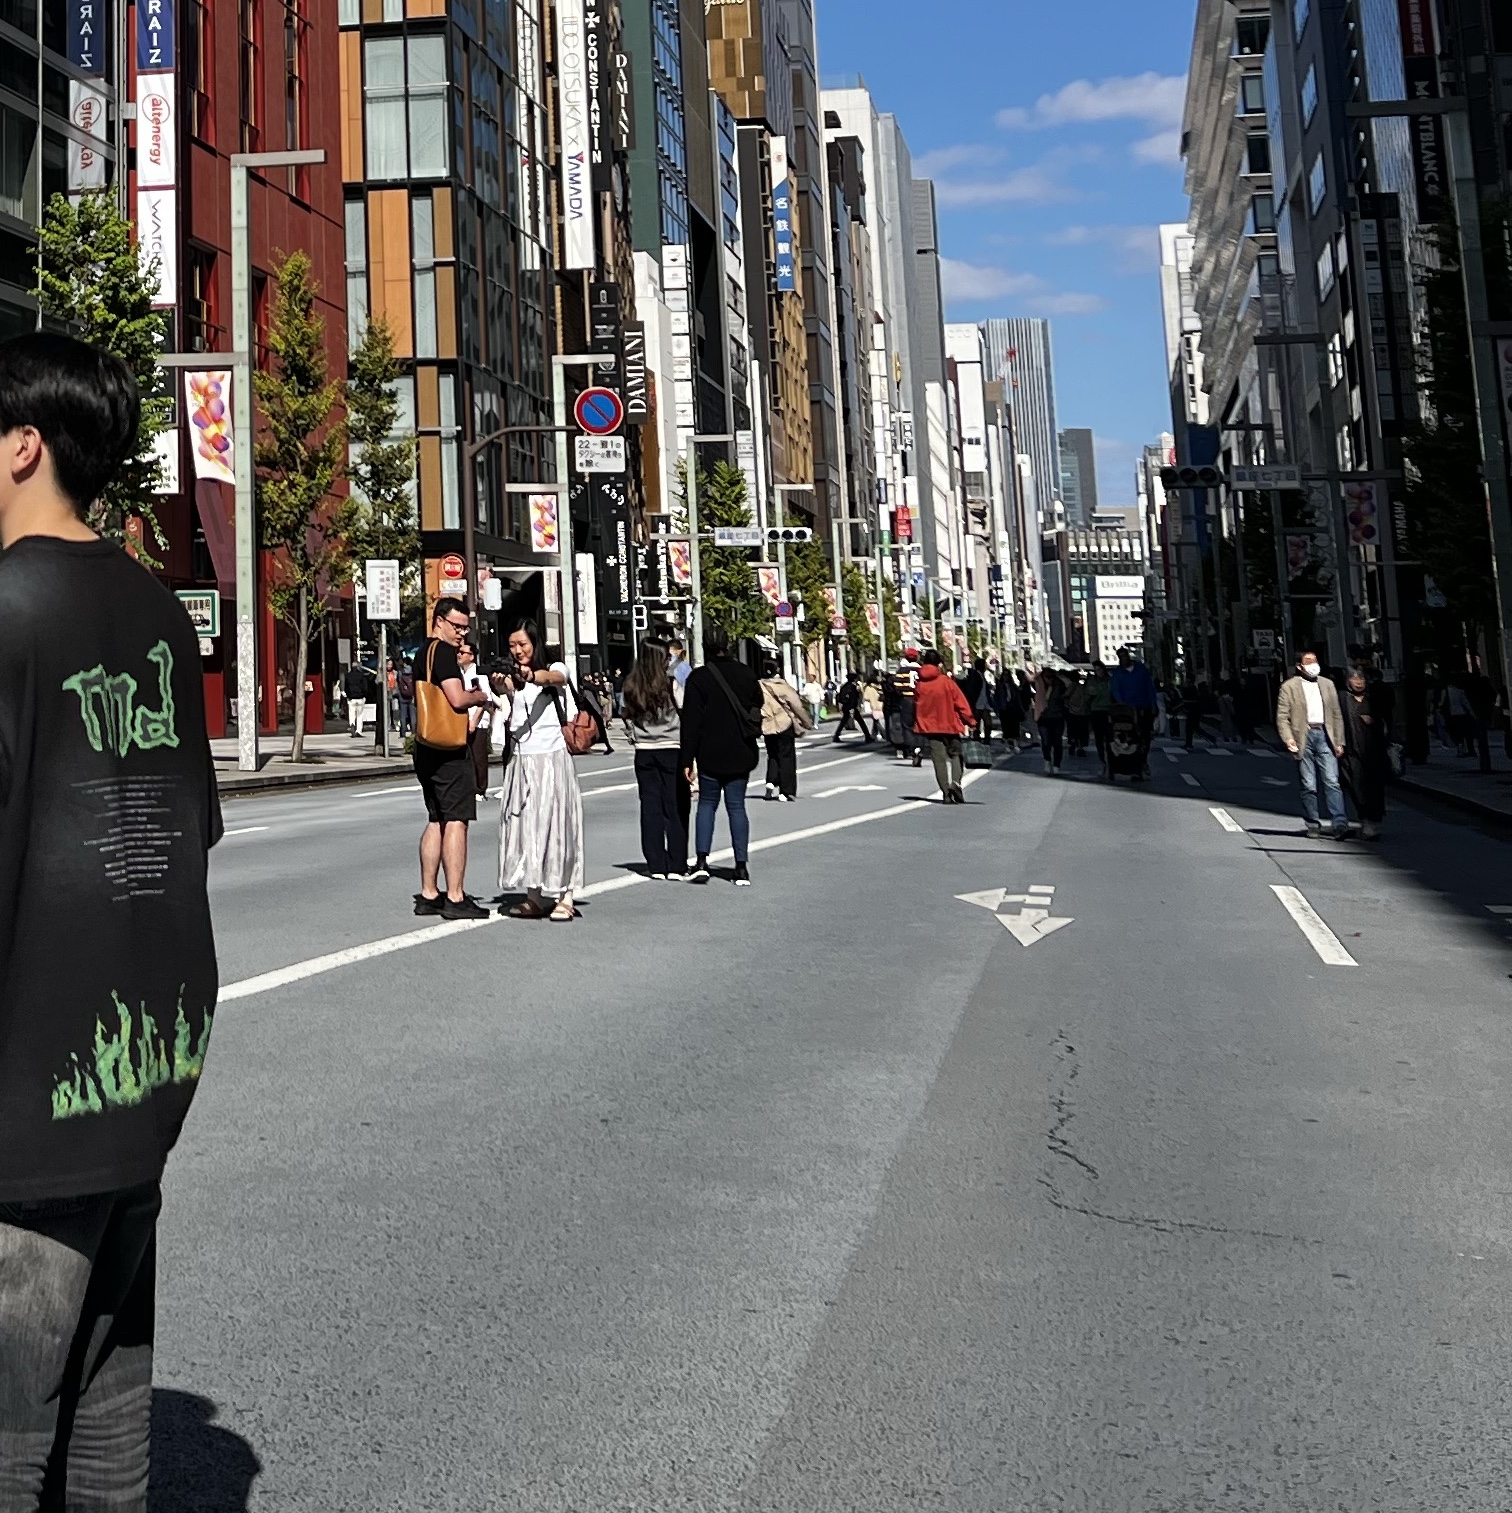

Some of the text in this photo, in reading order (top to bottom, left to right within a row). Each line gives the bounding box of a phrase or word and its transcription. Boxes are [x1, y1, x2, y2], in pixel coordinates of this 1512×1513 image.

[149, 97, 163, 167] altenergy
[588, 34, 602, 164] CONSTANTIN
[1414, 80, 1439, 182] MNTBLANC
[567, 152, 584, 220] YAMADA
[624, 331, 646, 413] DAMIANI
